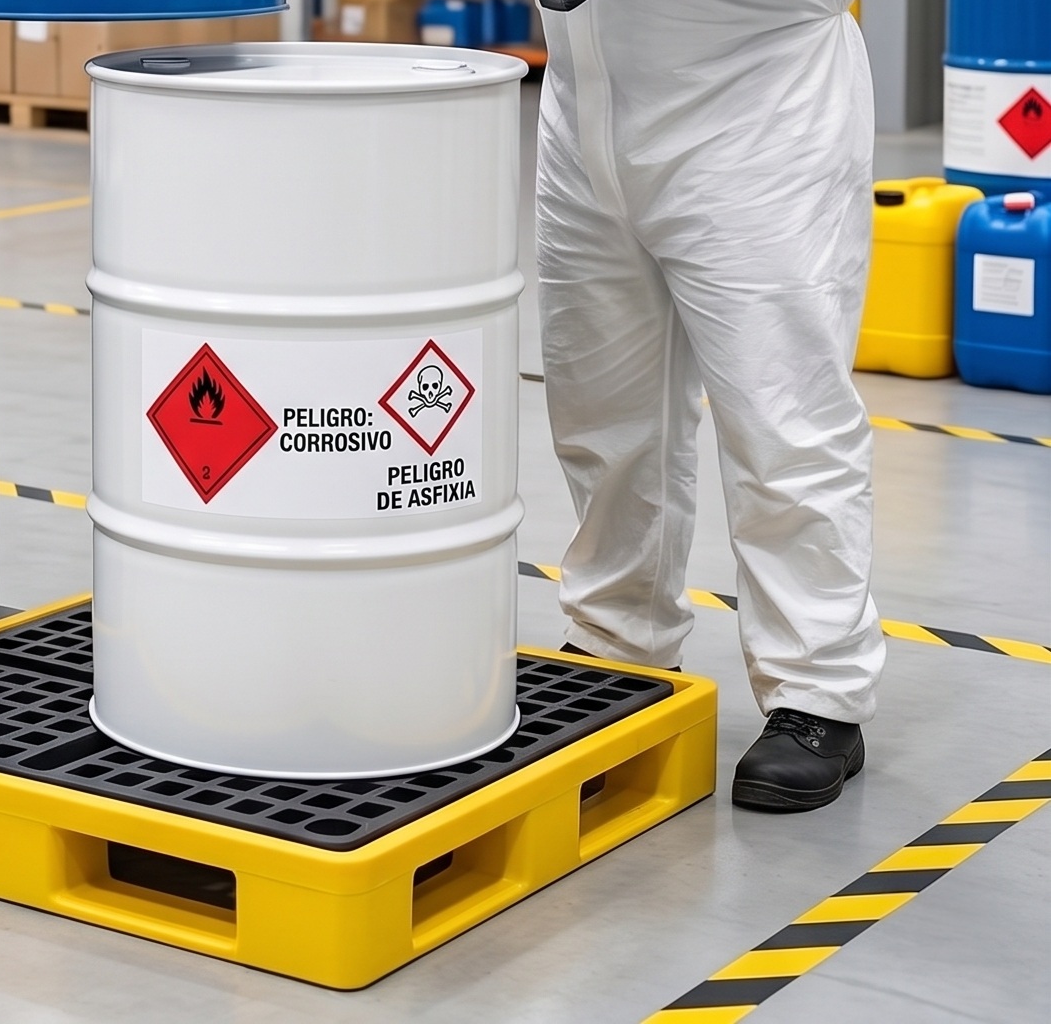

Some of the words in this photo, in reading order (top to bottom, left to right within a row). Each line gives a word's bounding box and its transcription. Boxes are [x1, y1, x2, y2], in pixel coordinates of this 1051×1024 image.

[283, 407, 374, 428] PELIGRO:
[279, 430, 393, 453] CORROSIVO
[201, 466, 211, 480] 2
[387, 457, 465, 486] PELIGRO
[376, 490, 403, 511] DE
[407, 480, 476, 509] ASFIXIA
